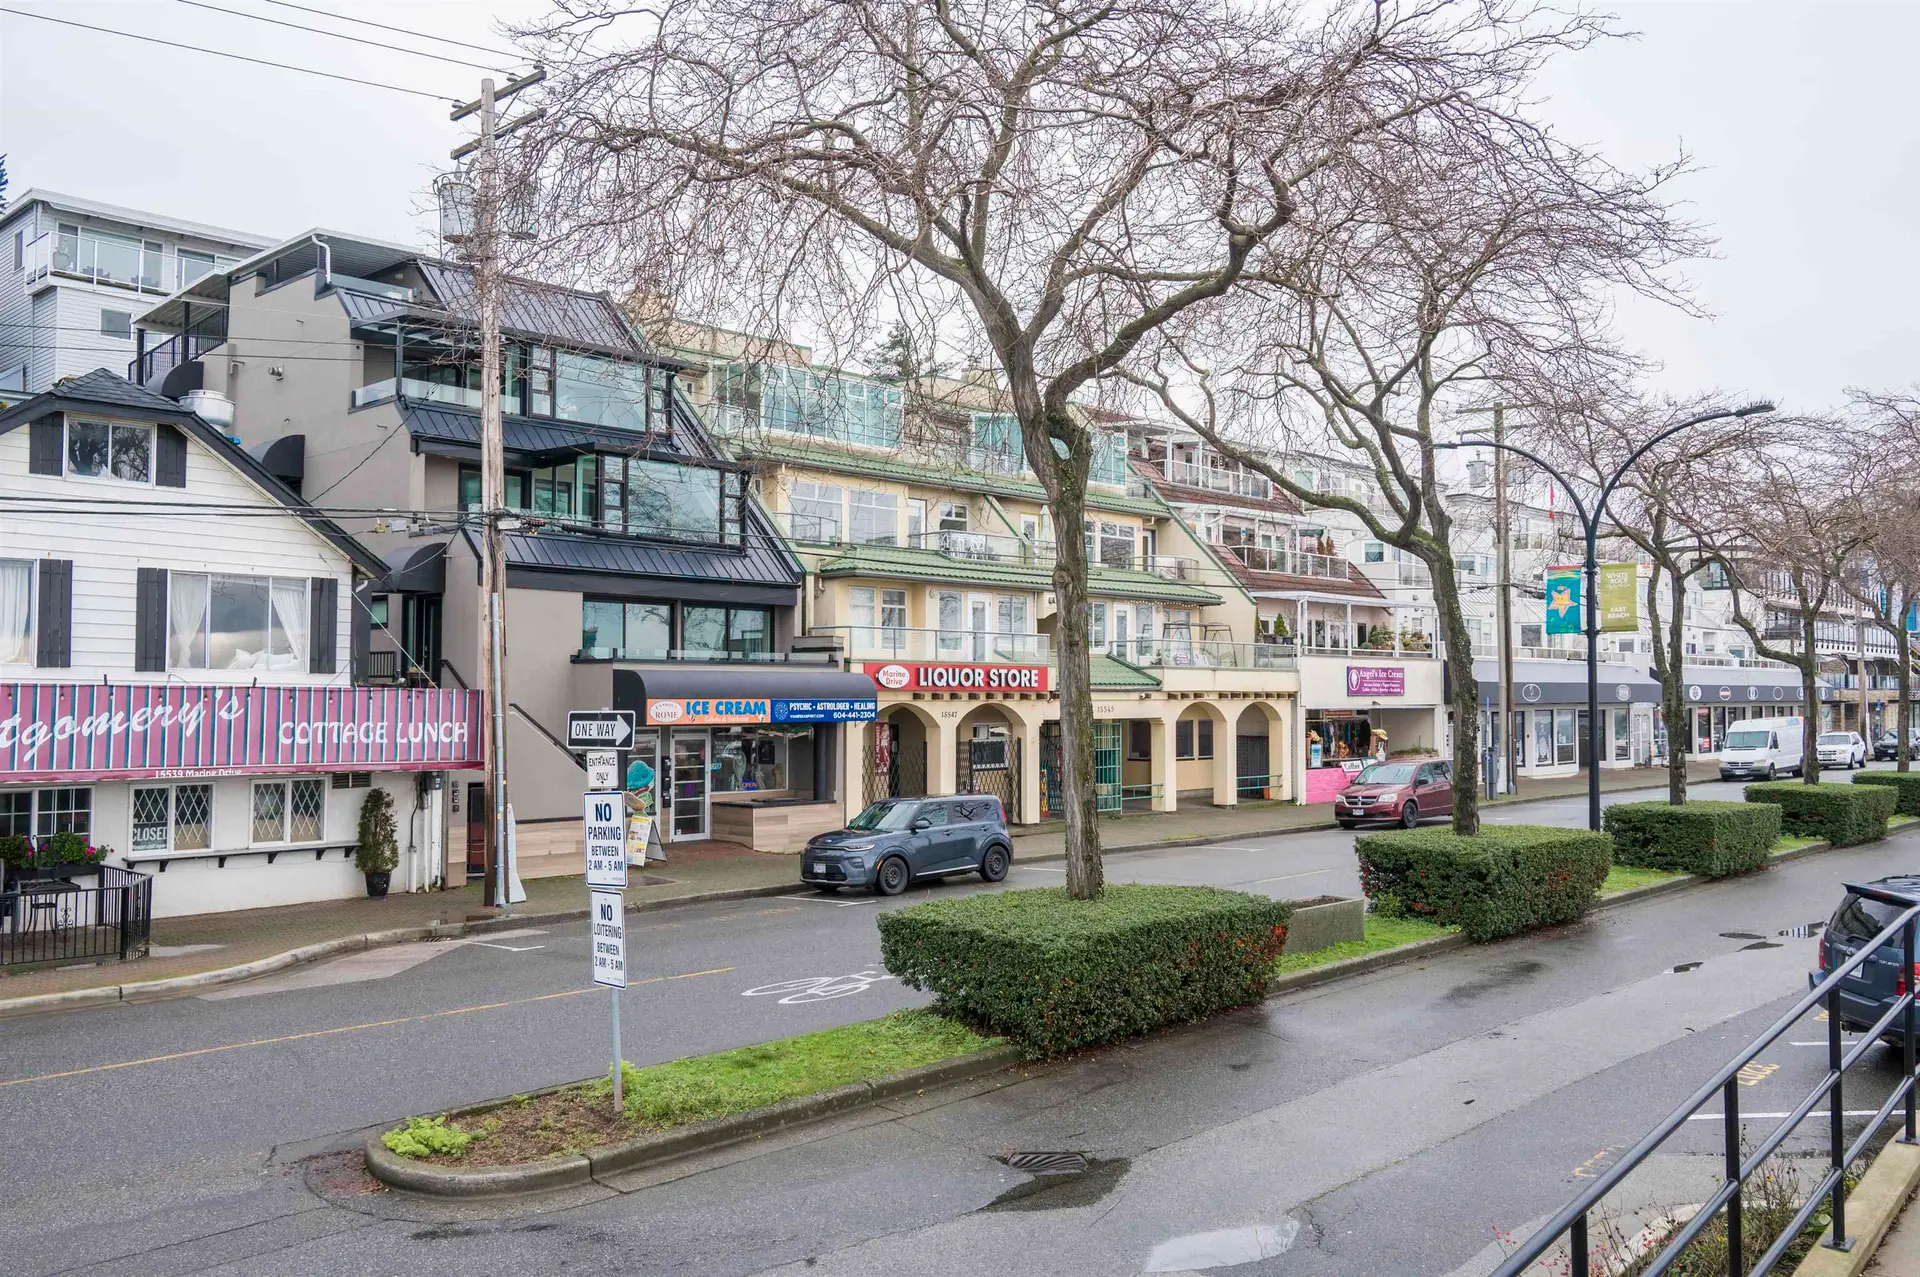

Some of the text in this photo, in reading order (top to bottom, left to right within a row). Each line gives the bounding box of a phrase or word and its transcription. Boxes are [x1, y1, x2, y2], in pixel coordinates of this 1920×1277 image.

[882, 670, 906, 678] Marine
[918, 667, 1038, 688] LIQUOR STORE
[1378, 670, 1387, 678] Ice
[886, 678, 902, 686] Drive
[686, 700, 766, 715] ICE CREAM
[790, 702, 812, 710] PSYCHIC
[816, 702, 849, 710] ASTROLOGER
[655, 710, 678, 719] ROME
[279, 722, 468, 744] COTTAGE LUNCH
[575, 723, 616, 737] ONE WAY
[588, 756, 616, 766] ENTRANCE
[155, 770, 184, 778] 15539
[596, 772, 609, 782] ONLY
[595, 803, 612, 822] NO
[588, 826, 621, 840] PARKING
[591, 846, 619, 856] BETWEEN
[589, 860, 592, 870] 2
[594, 860, 602, 870] AM
[608, 861, 612, 871] 5
[614, 861, 623, 871] AM
[600, 904, 612, 921] NO
[594, 923, 622, 939] LOITERING
[597, 942, 619, 956] BETWEEN
[595, 956, 598, 966] 2
[599, 957, 606, 968] AM
[611, 959, 614, 970] 5
[615, 960, 623, 971] AM
